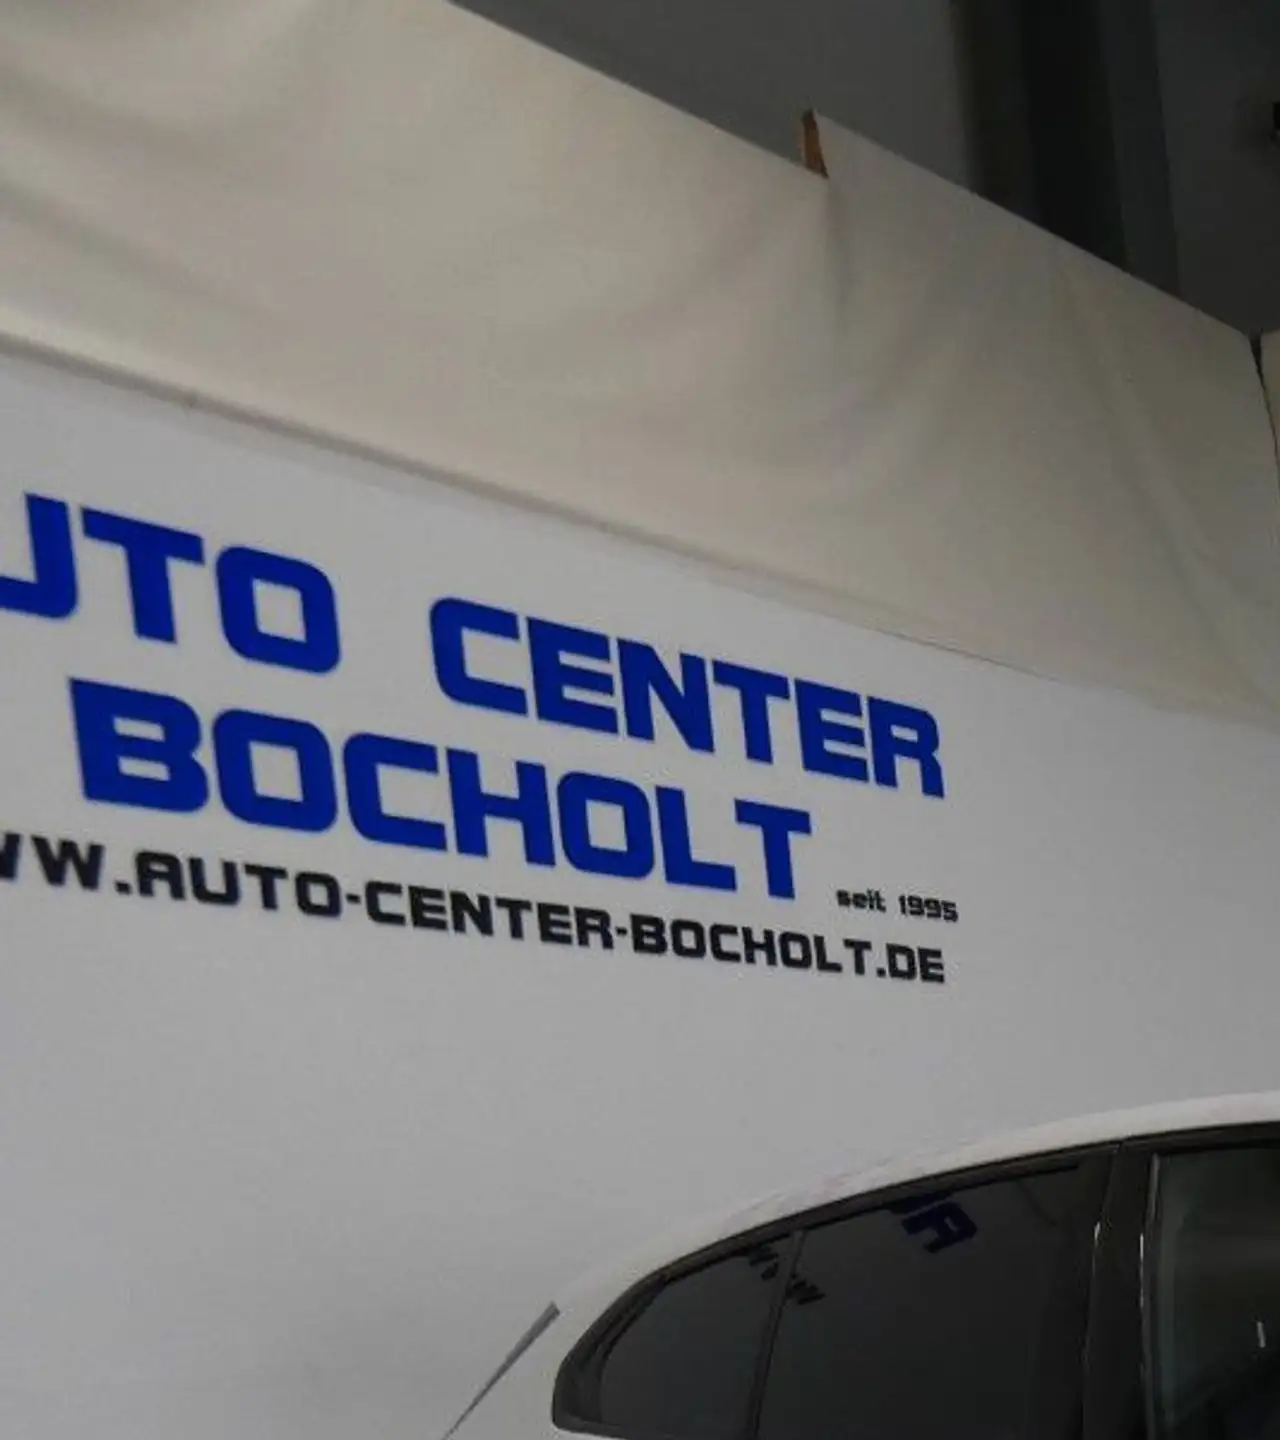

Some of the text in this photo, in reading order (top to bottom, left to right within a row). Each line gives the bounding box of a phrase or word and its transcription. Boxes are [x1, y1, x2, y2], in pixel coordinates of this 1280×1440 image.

[429, 597, 946, 797] CENTER
[69, 678, 959, 923] BOCHOLT seit 1995
[0, 831, 945, 984] W.AUTO-CENTER-BOCHOLT.DE
